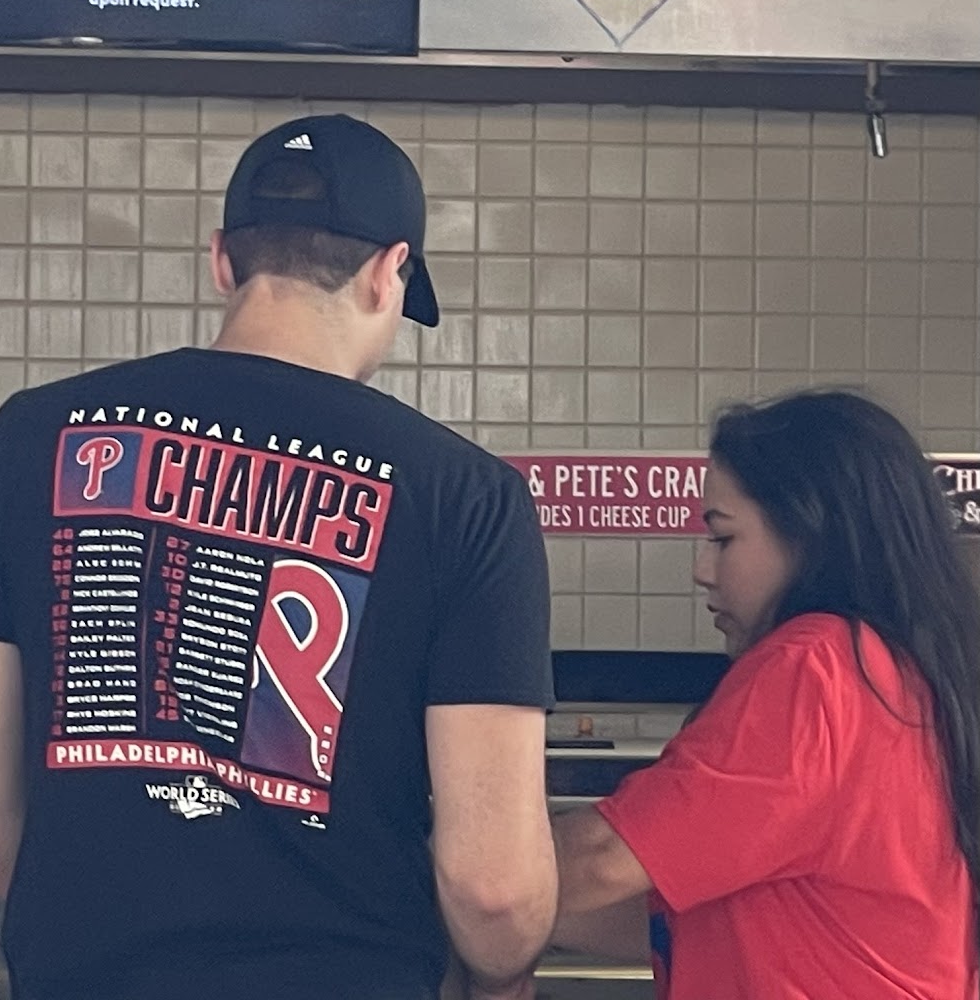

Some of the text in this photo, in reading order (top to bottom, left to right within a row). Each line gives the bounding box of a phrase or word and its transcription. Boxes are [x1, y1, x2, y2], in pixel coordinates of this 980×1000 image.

[69, 406, 394, 480] NATIONAL LEAGUE
[528, 465, 545, 497] &
[555, 465, 639, 498] PETE'S
[144, 438, 381, 564] CHAMPS
[589, 505, 651, 528] CHEESE
[656, 506, 691, 528] CUP
[145, 783, 200, 802] WORLD
